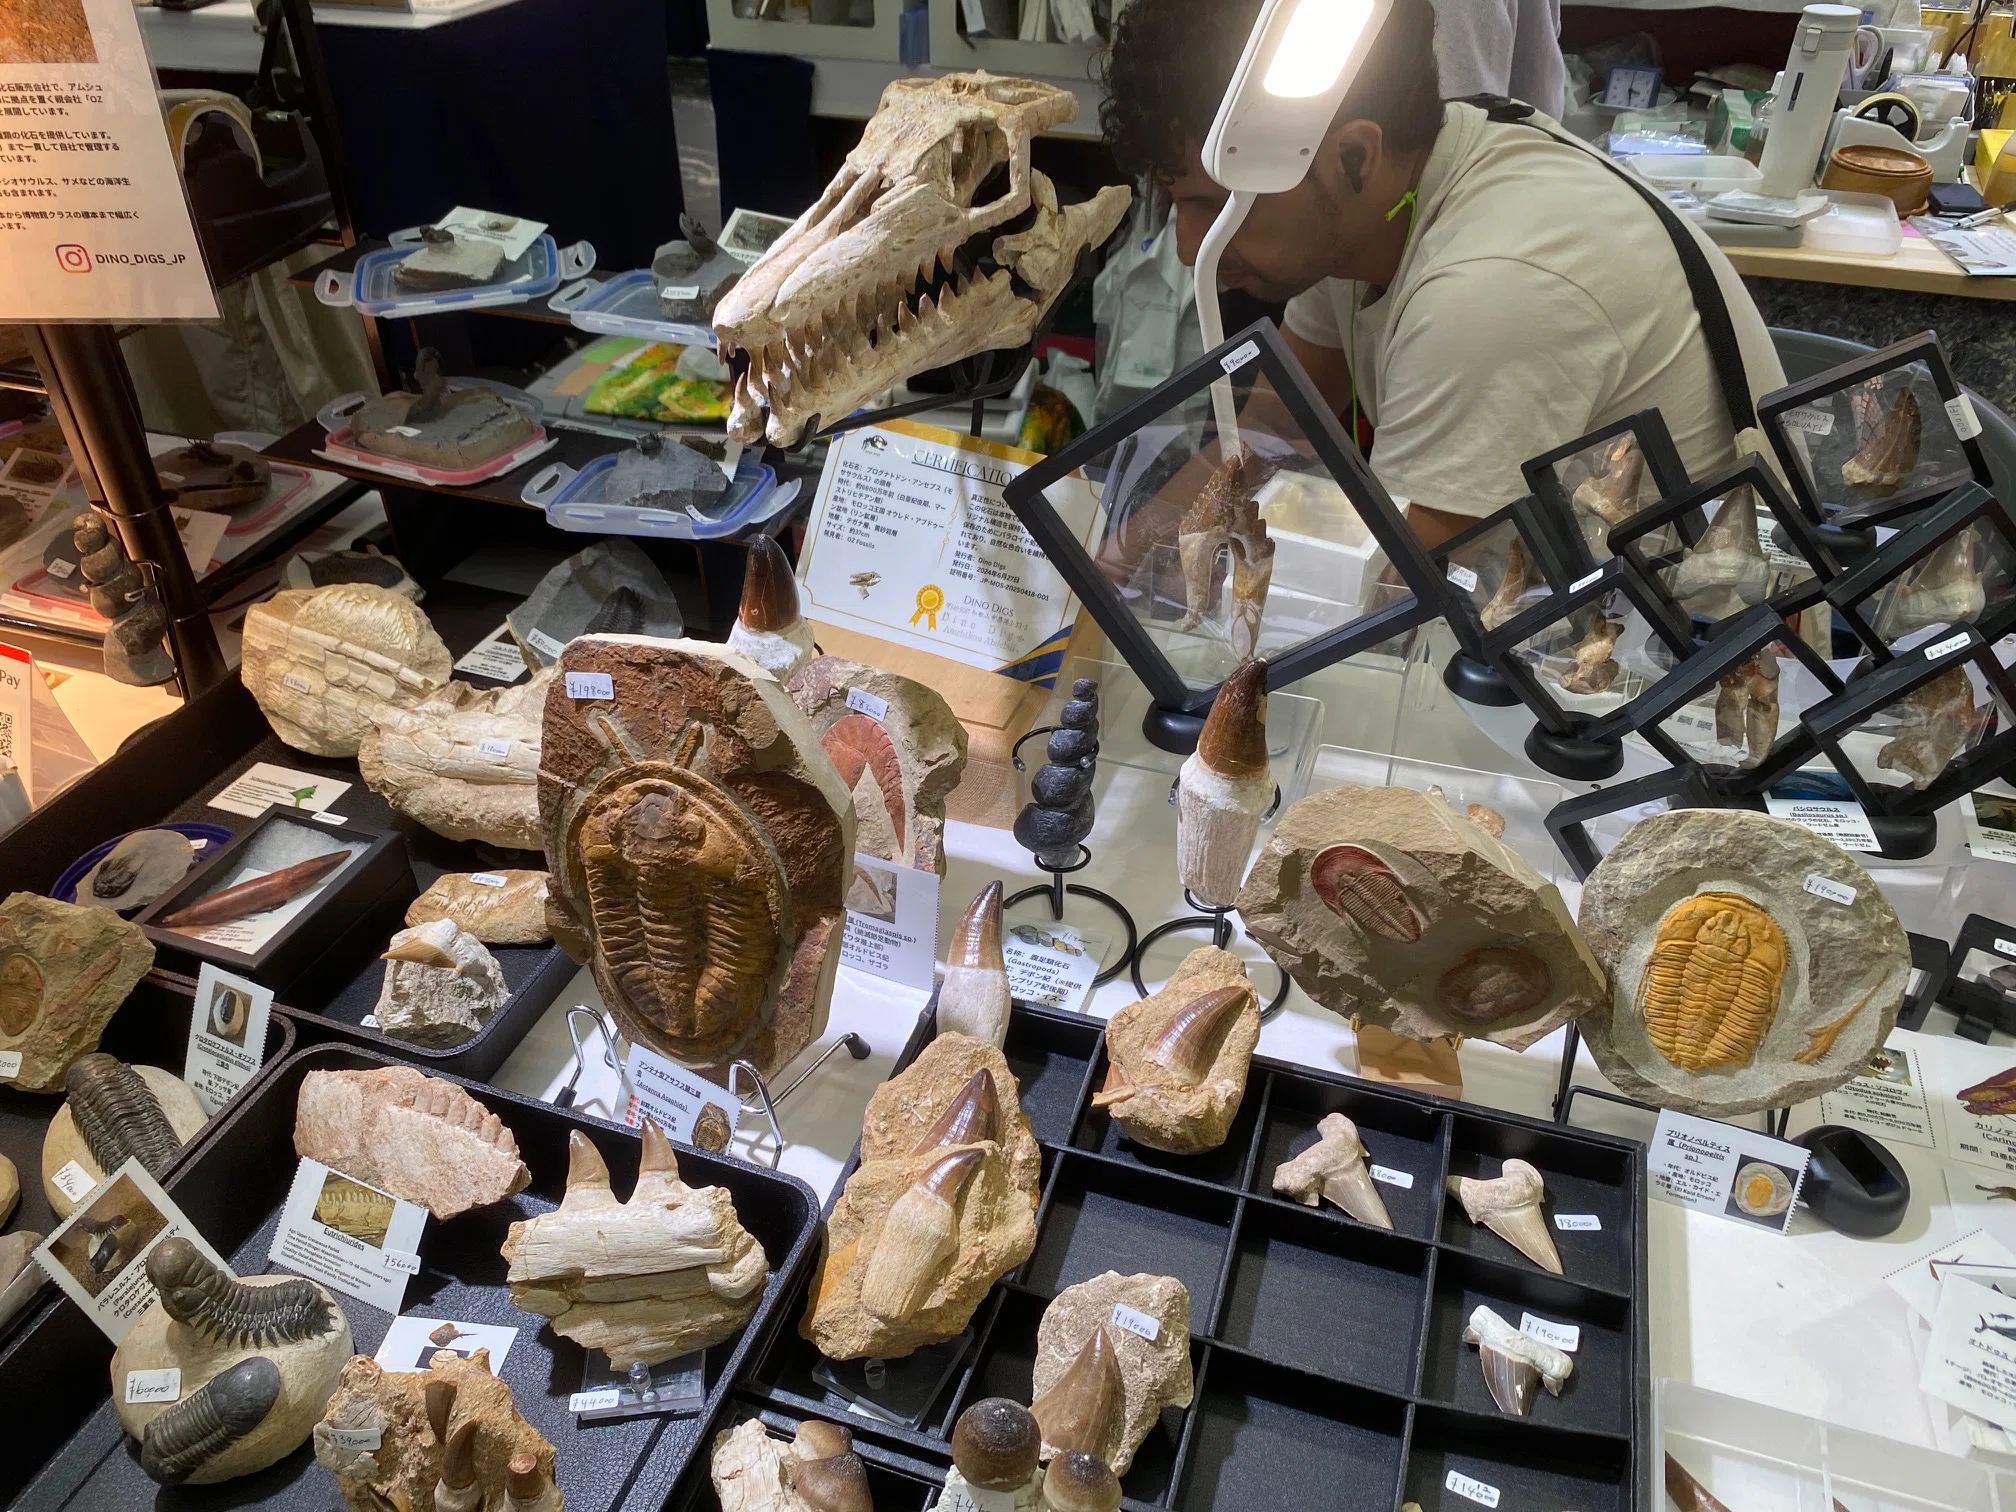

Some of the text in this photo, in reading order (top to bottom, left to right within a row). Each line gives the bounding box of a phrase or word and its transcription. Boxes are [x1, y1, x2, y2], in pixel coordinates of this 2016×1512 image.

[95, 253, 187, 266] DINO_DIGS_JP
[912, 449, 1019, 487] CERTIFICATIO
[1007, 956, 1060, 976] (Gastropods)
